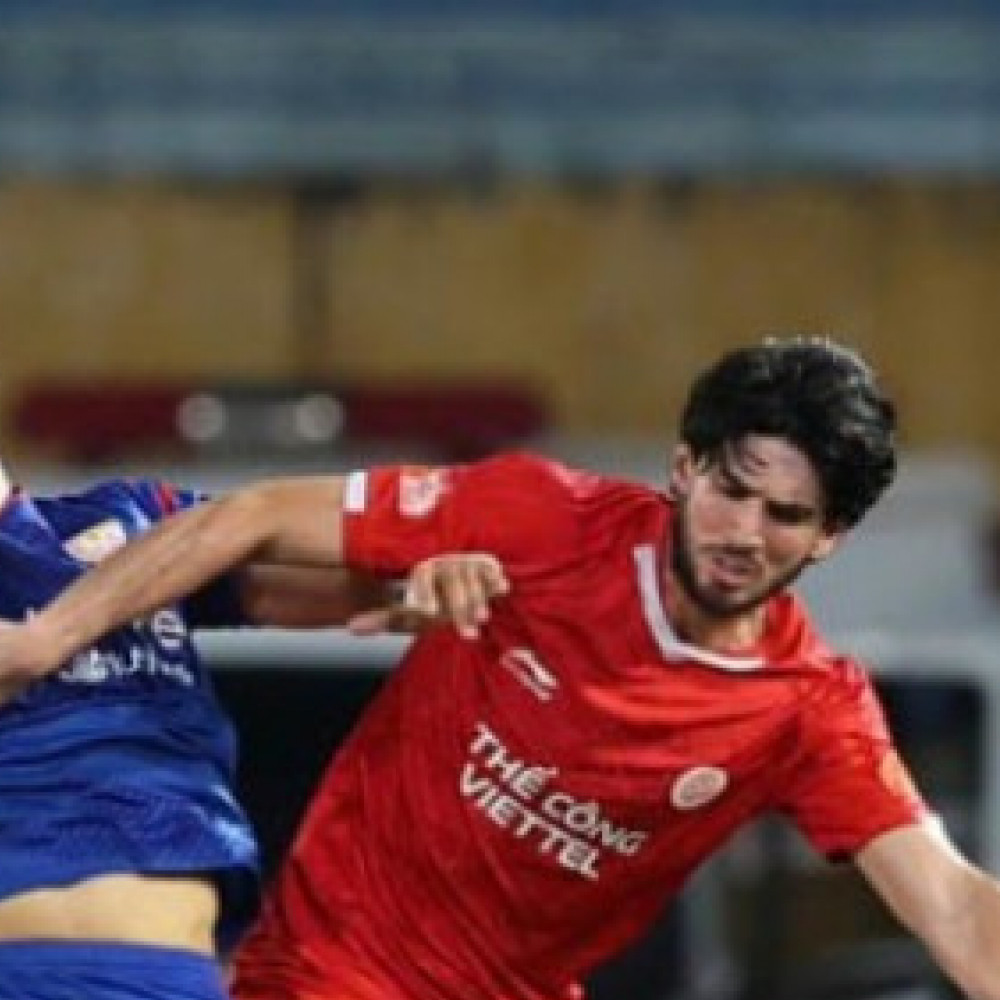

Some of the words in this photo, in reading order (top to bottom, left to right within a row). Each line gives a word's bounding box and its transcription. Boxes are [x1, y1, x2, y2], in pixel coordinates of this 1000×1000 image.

[460, 762, 600, 879] VIETTEL
[470, 723, 559, 799] THẾ
[543, 792, 647, 854] CÔNG
